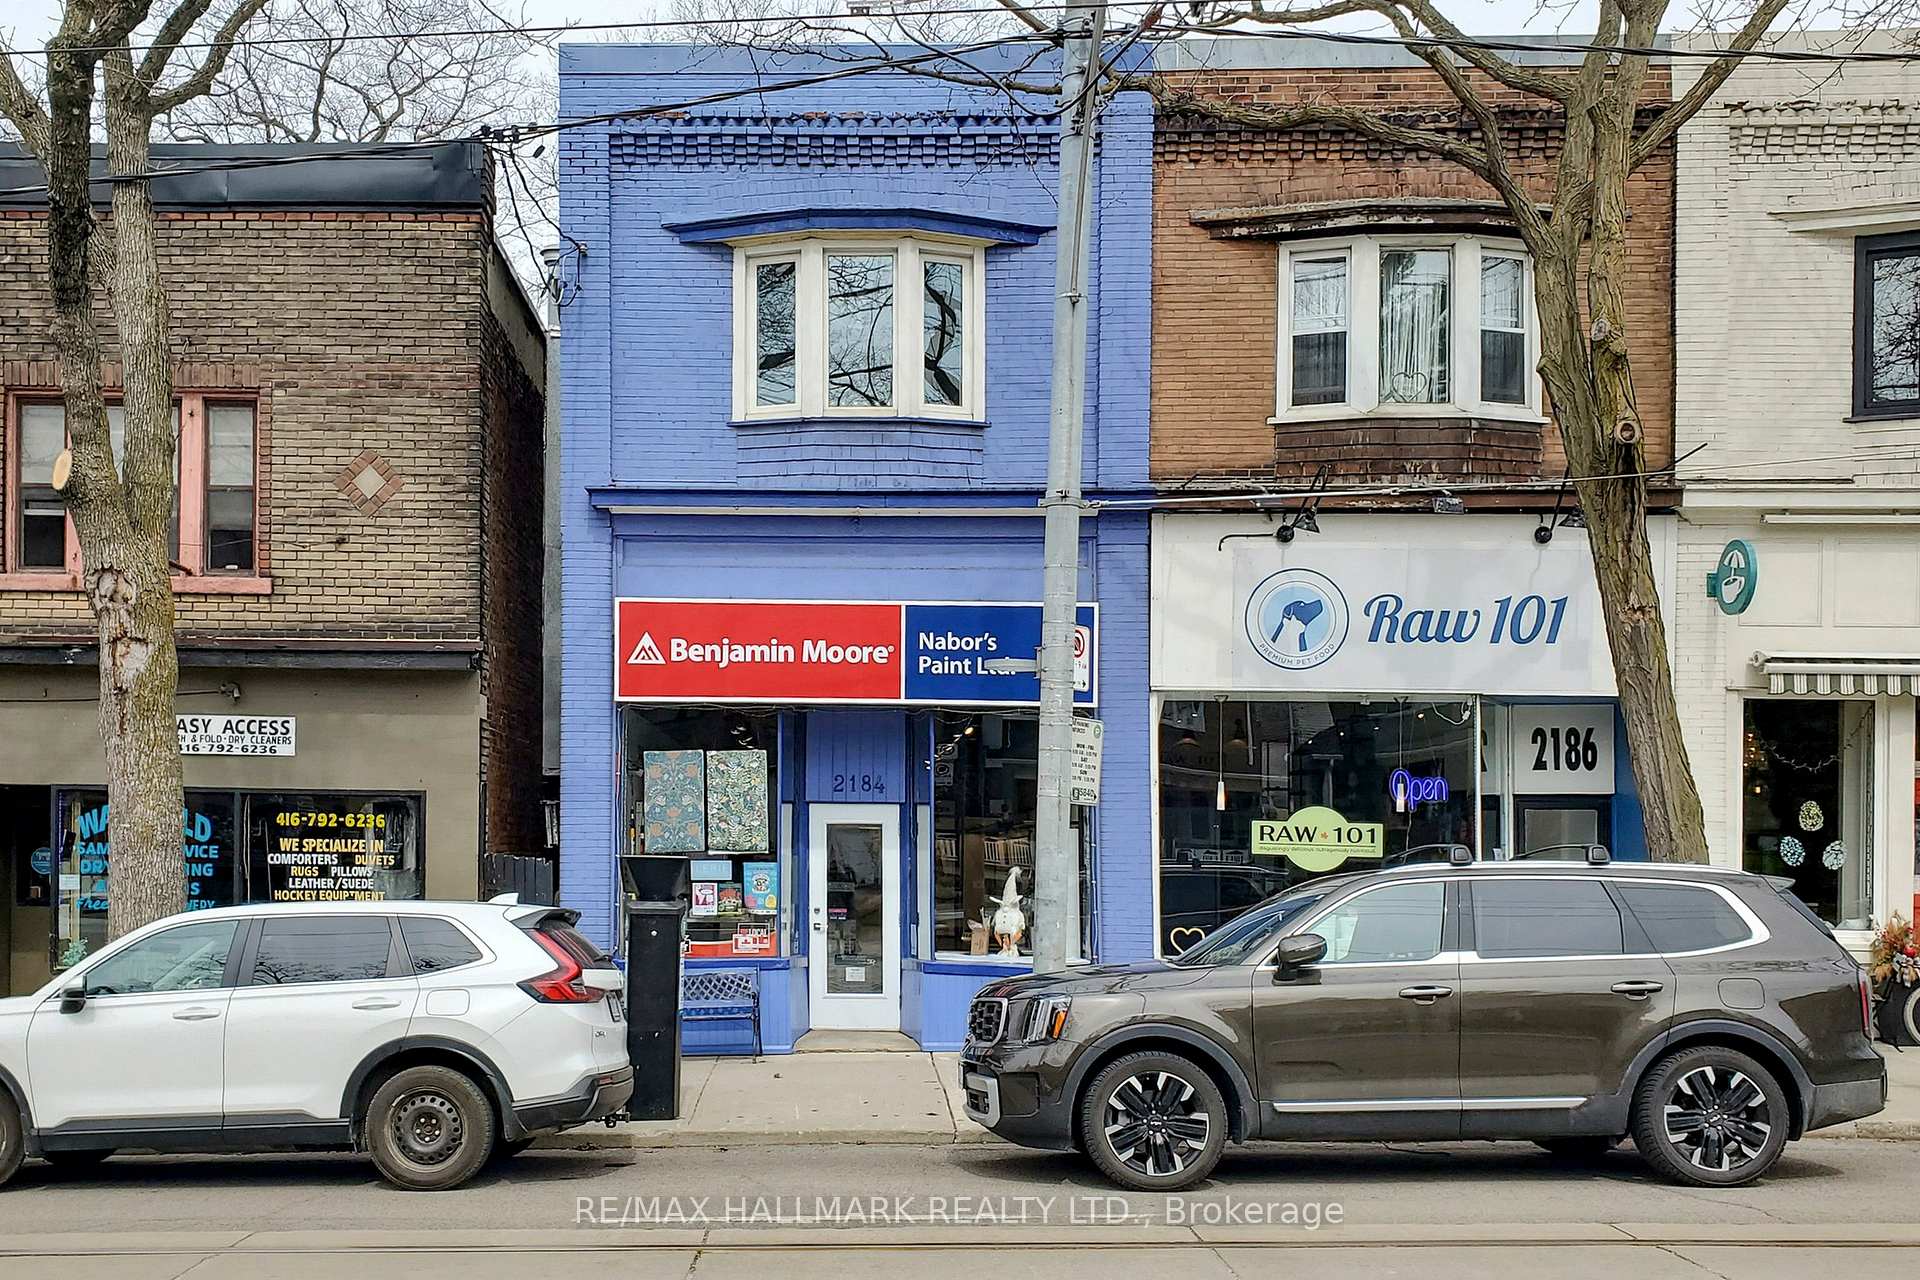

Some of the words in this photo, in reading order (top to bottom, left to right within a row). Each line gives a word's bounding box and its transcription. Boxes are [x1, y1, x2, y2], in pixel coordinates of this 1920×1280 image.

[1363, 593, 1481, 644] Raw
[1489, 594, 1568, 644] 101
[918, 631, 997, 650] Nabor's
[670, 638, 795, 668] Benjamin
[1260, 643, 1293, 665] PREMIUM
[1315, 643, 1335, 661] FOOD
[918, 656, 972, 674] Paint
[177, 718, 212, 733] ASY
[222, 719, 290, 735] ACCESS
[250, 736, 292, 745] CLEANERS
[1531, 727, 1598, 771] 2186
[833, 774, 885, 794] 2184
[1389, 768, 1449, 812] Open
[77, 804, 110, 840] WA
[276, 812, 386, 828] 416-792-6236
[1259, 824, 1318, 842] RAW
[1333, 826, 1376, 844] 101
[78, 842, 110, 856] SAM
[184, 845, 219, 859] VICE
[280, 838, 299, 851] WE
[302, 838, 366, 852] SPECIALIZE
[370, 839, 384, 853] IN
[267, 853, 338, 865] COMFORTERS
[355, 855, 395, 866] DUVETS
[291, 866, 319, 877] RUGS
[331, 866, 373, 877] PILLOWS
[75, 897, 109, 910] Free
[274, 890, 317, 901] HOCKEY
